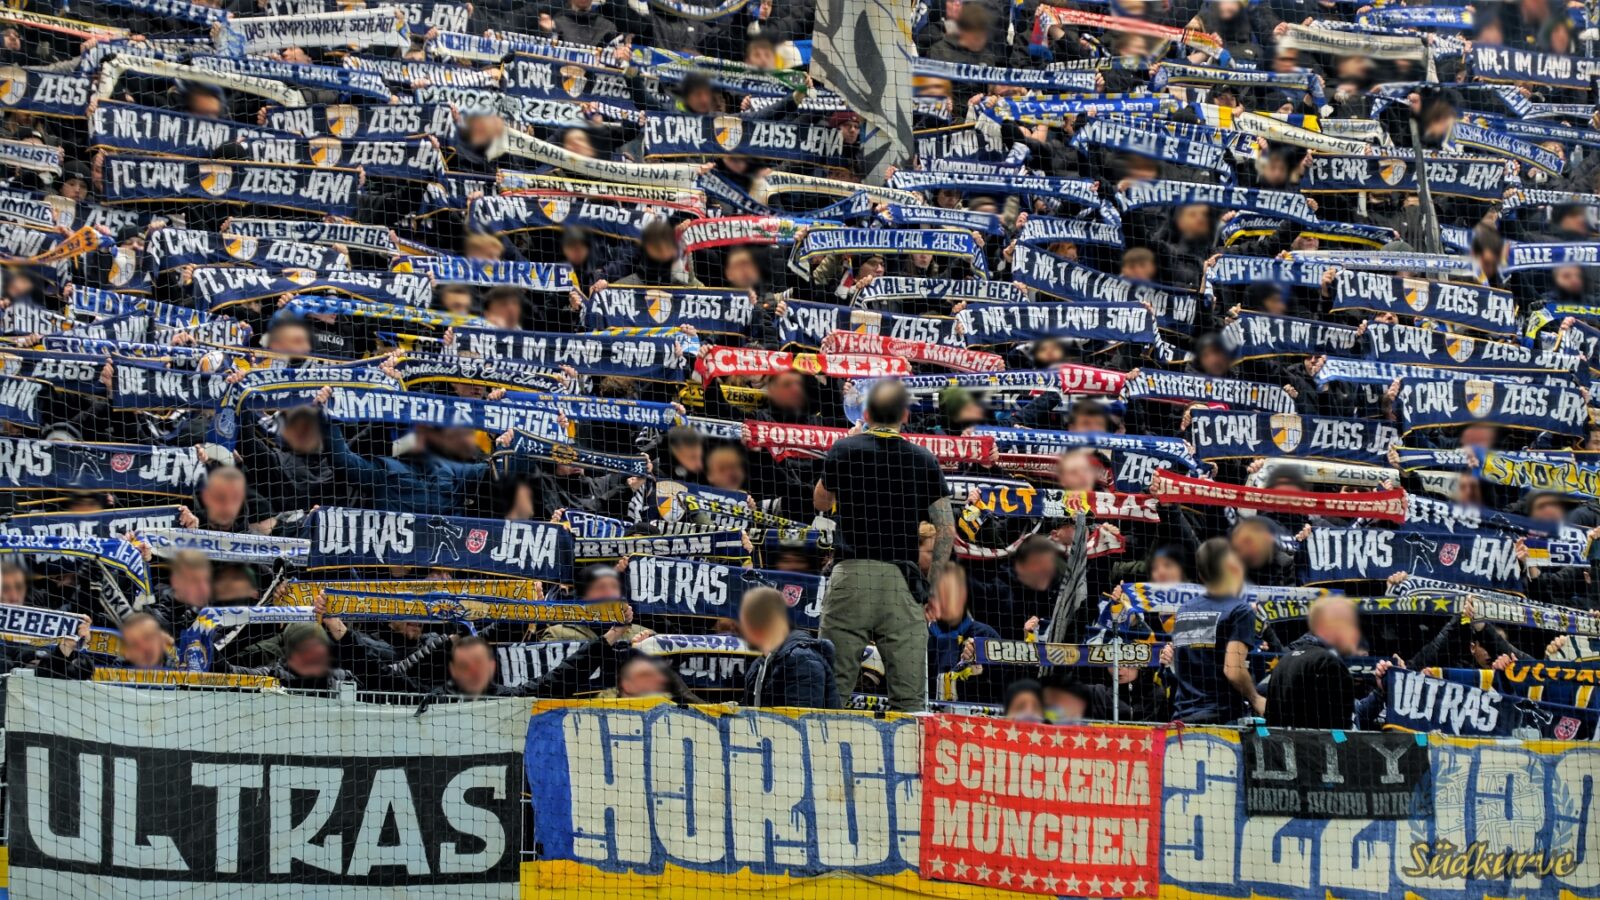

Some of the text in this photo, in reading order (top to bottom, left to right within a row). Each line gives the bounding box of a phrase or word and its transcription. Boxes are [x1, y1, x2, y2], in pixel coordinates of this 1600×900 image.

[518, 60, 555, 95] CARL
[1514, 52, 1532, 75] IM
[34, 73, 89, 106] ZEISS
[158, 115, 181, 149] IM
[367, 105, 420, 135] ZEISS
[664, 115, 706, 150] CARL
[751, 121, 797, 150] ZEISS
[800, 122, 844, 157] JENA
[350, 139, 405, 167] ZEISS
[508, 136, 526, 151] FC
[583, 160, 628, 179] ZEISS
[631, 165, 671, 182] JENA
[110, 159, 353, 206] FC CARL ZEISS JENA
[526, 176, 678, 203] JENA ET LAUSANNE
[1309, 158, 1504, 191] FC CARL JENA
[162, 229, 327, 271] CARL ZEISS
[894, 229, 928, 250] CARL
[931, 231, 968, 251] ZEISS
[1514, 246, 1553, 265] ALLE
[198, 267, 226, 302] FC
[386, 273, 434, 308] JENA
[1355, 270, 1398, 304] CARL
[1436, 285, 1479, 315] ZEISS
[679, 294, 721, 319] ZEISS
[1027, 307, 1050, 330] IM
[1056, 304, 1101, 332] LAND
[1106, 305, 1148, 332] SIND
[890, 315, 942, 344] ZEISS
[1370, 324, 1393, 358] FC
[1393, 325, 1438, 360] CARL
[522, 335, 547, 365] IM
[551, 337, 604, 369] LAND
[610, 341, 656, 369] SIND
[118, 365, 149, 397] DIE
[294, 368, 352, 383] ZEISS
[1064, 368, 1121, 391] ULT
[579, 402, 660, 425] ZEISS JENA
[1416, 380, 1549, 418] CARL ZEISS
[1215, 414, 1262, 452] CARL
[1310, 420, 1363, 450] ZEISS
[1094, 491, 1158, 521] RAS
[174, 537, 221, 553] CARL
[229, 540, 282, 556] ZEISS
[317, 504, 560, 570] ULTRAS JENA
[1307, 526, 1395, 578] ULTRAS
[1460, 534, 1524, 581] JENA
[628, 557, 730, 615] ULTRAS
[1393, 671, 1502, 736] ULTRAS
[25, 746, 507, 876] ULTRAS
[931, 738, 1151, 867] SCHICKERIA MÜNCHEN
